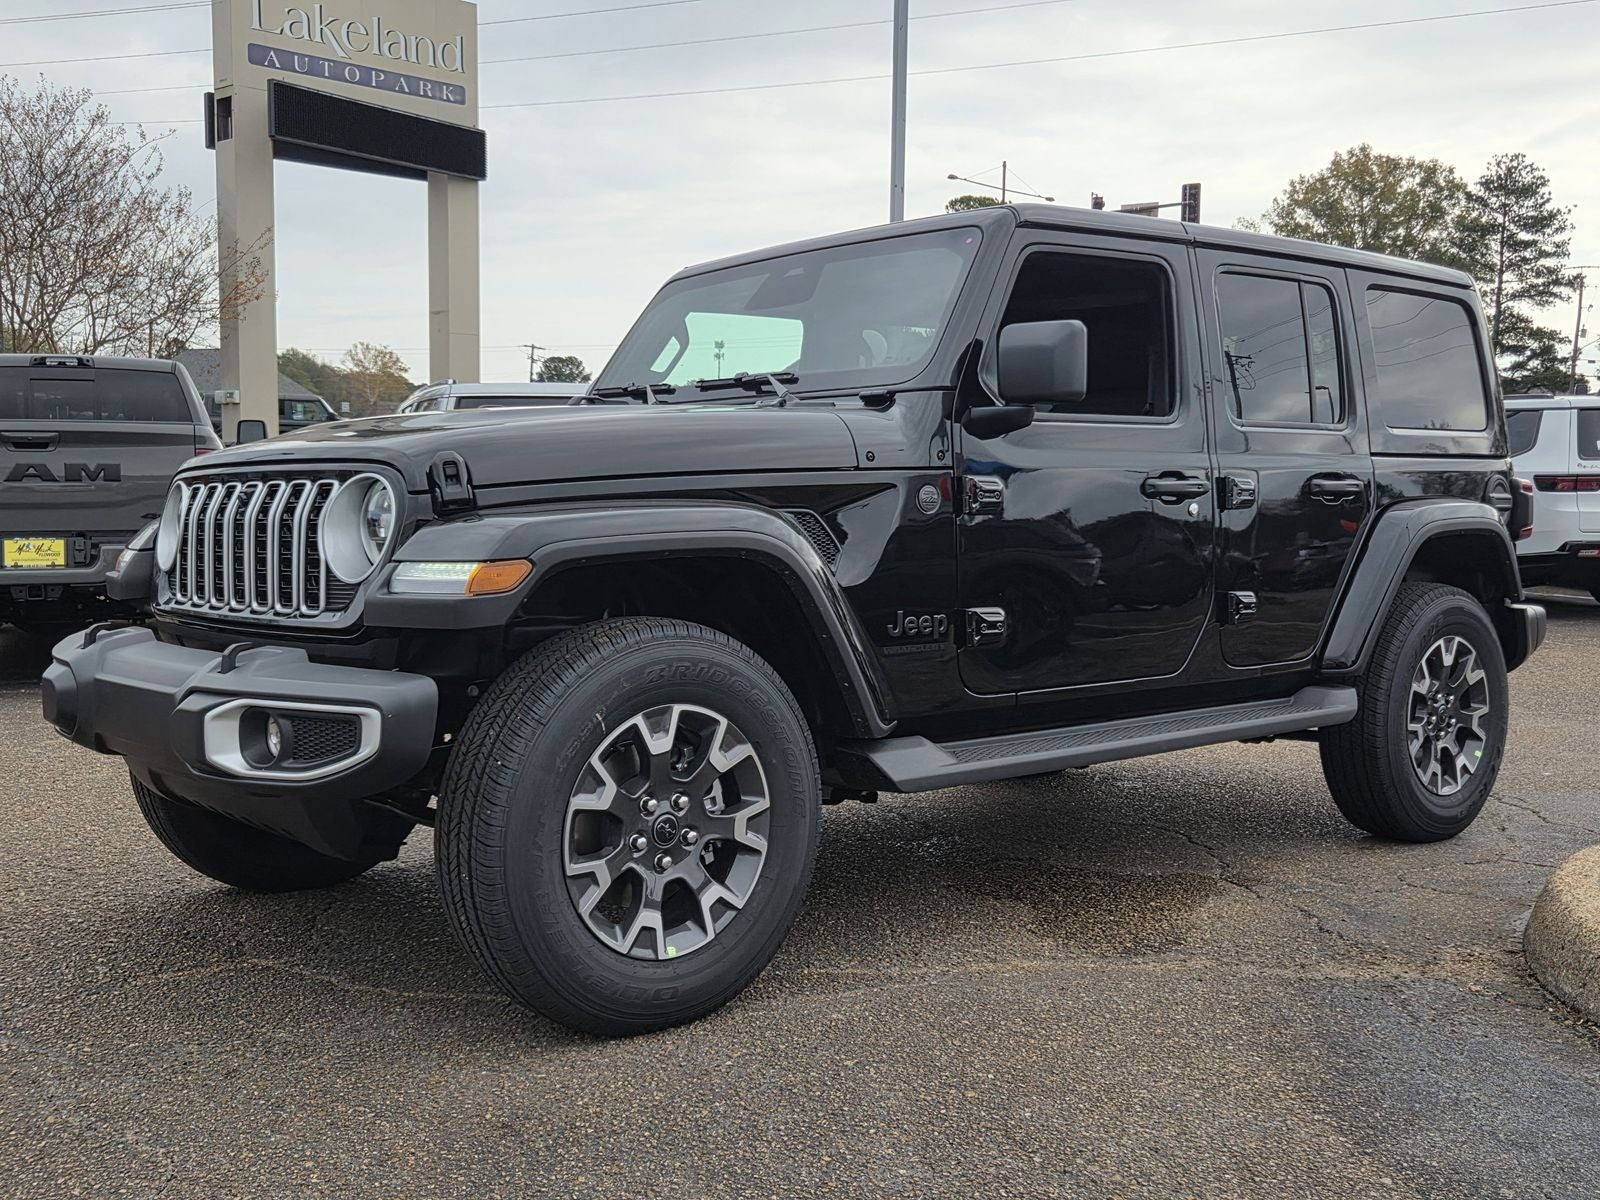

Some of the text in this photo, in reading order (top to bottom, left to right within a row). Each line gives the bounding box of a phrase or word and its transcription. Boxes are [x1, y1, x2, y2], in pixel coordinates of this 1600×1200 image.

[250, 0, 466, 74] Lakeland
[263, 49, 456, 103] AUTOPARK
[887, 610, 948, 639] Jeep
